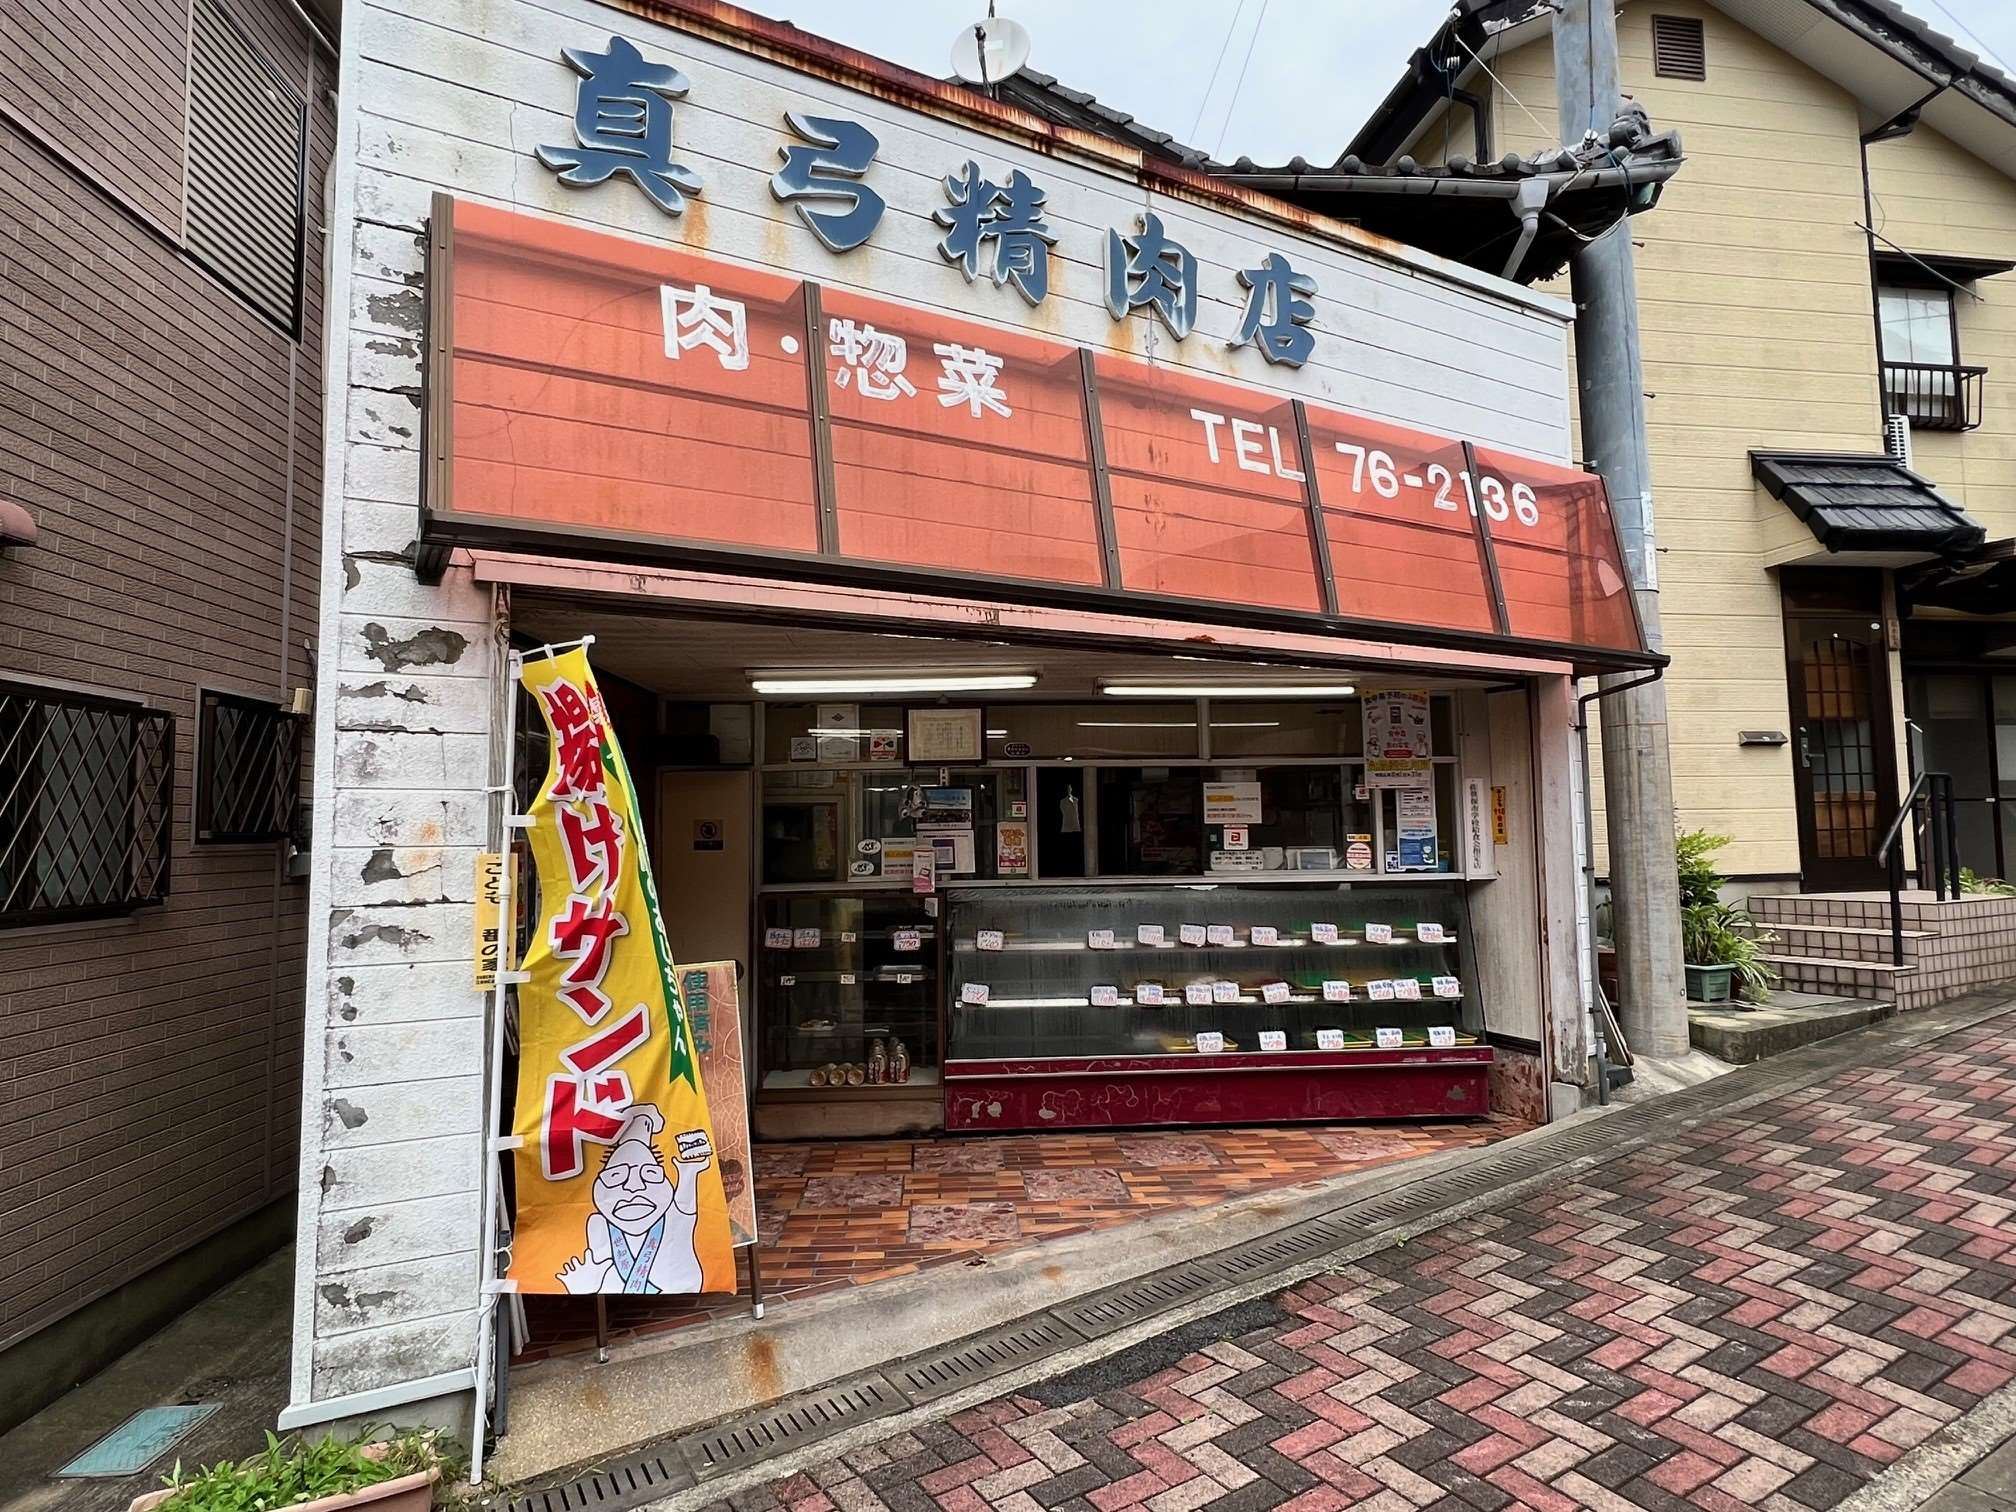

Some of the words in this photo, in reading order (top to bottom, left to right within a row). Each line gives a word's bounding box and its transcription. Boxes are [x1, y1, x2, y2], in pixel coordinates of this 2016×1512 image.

[534, 35, 1319, 368] 真弓精肉店
[659, 284, 1013, 418] 肉・惣菜
[1189, 408, 1307, 483] TEL
[1335, 442, 1540, 527] 76-2136
